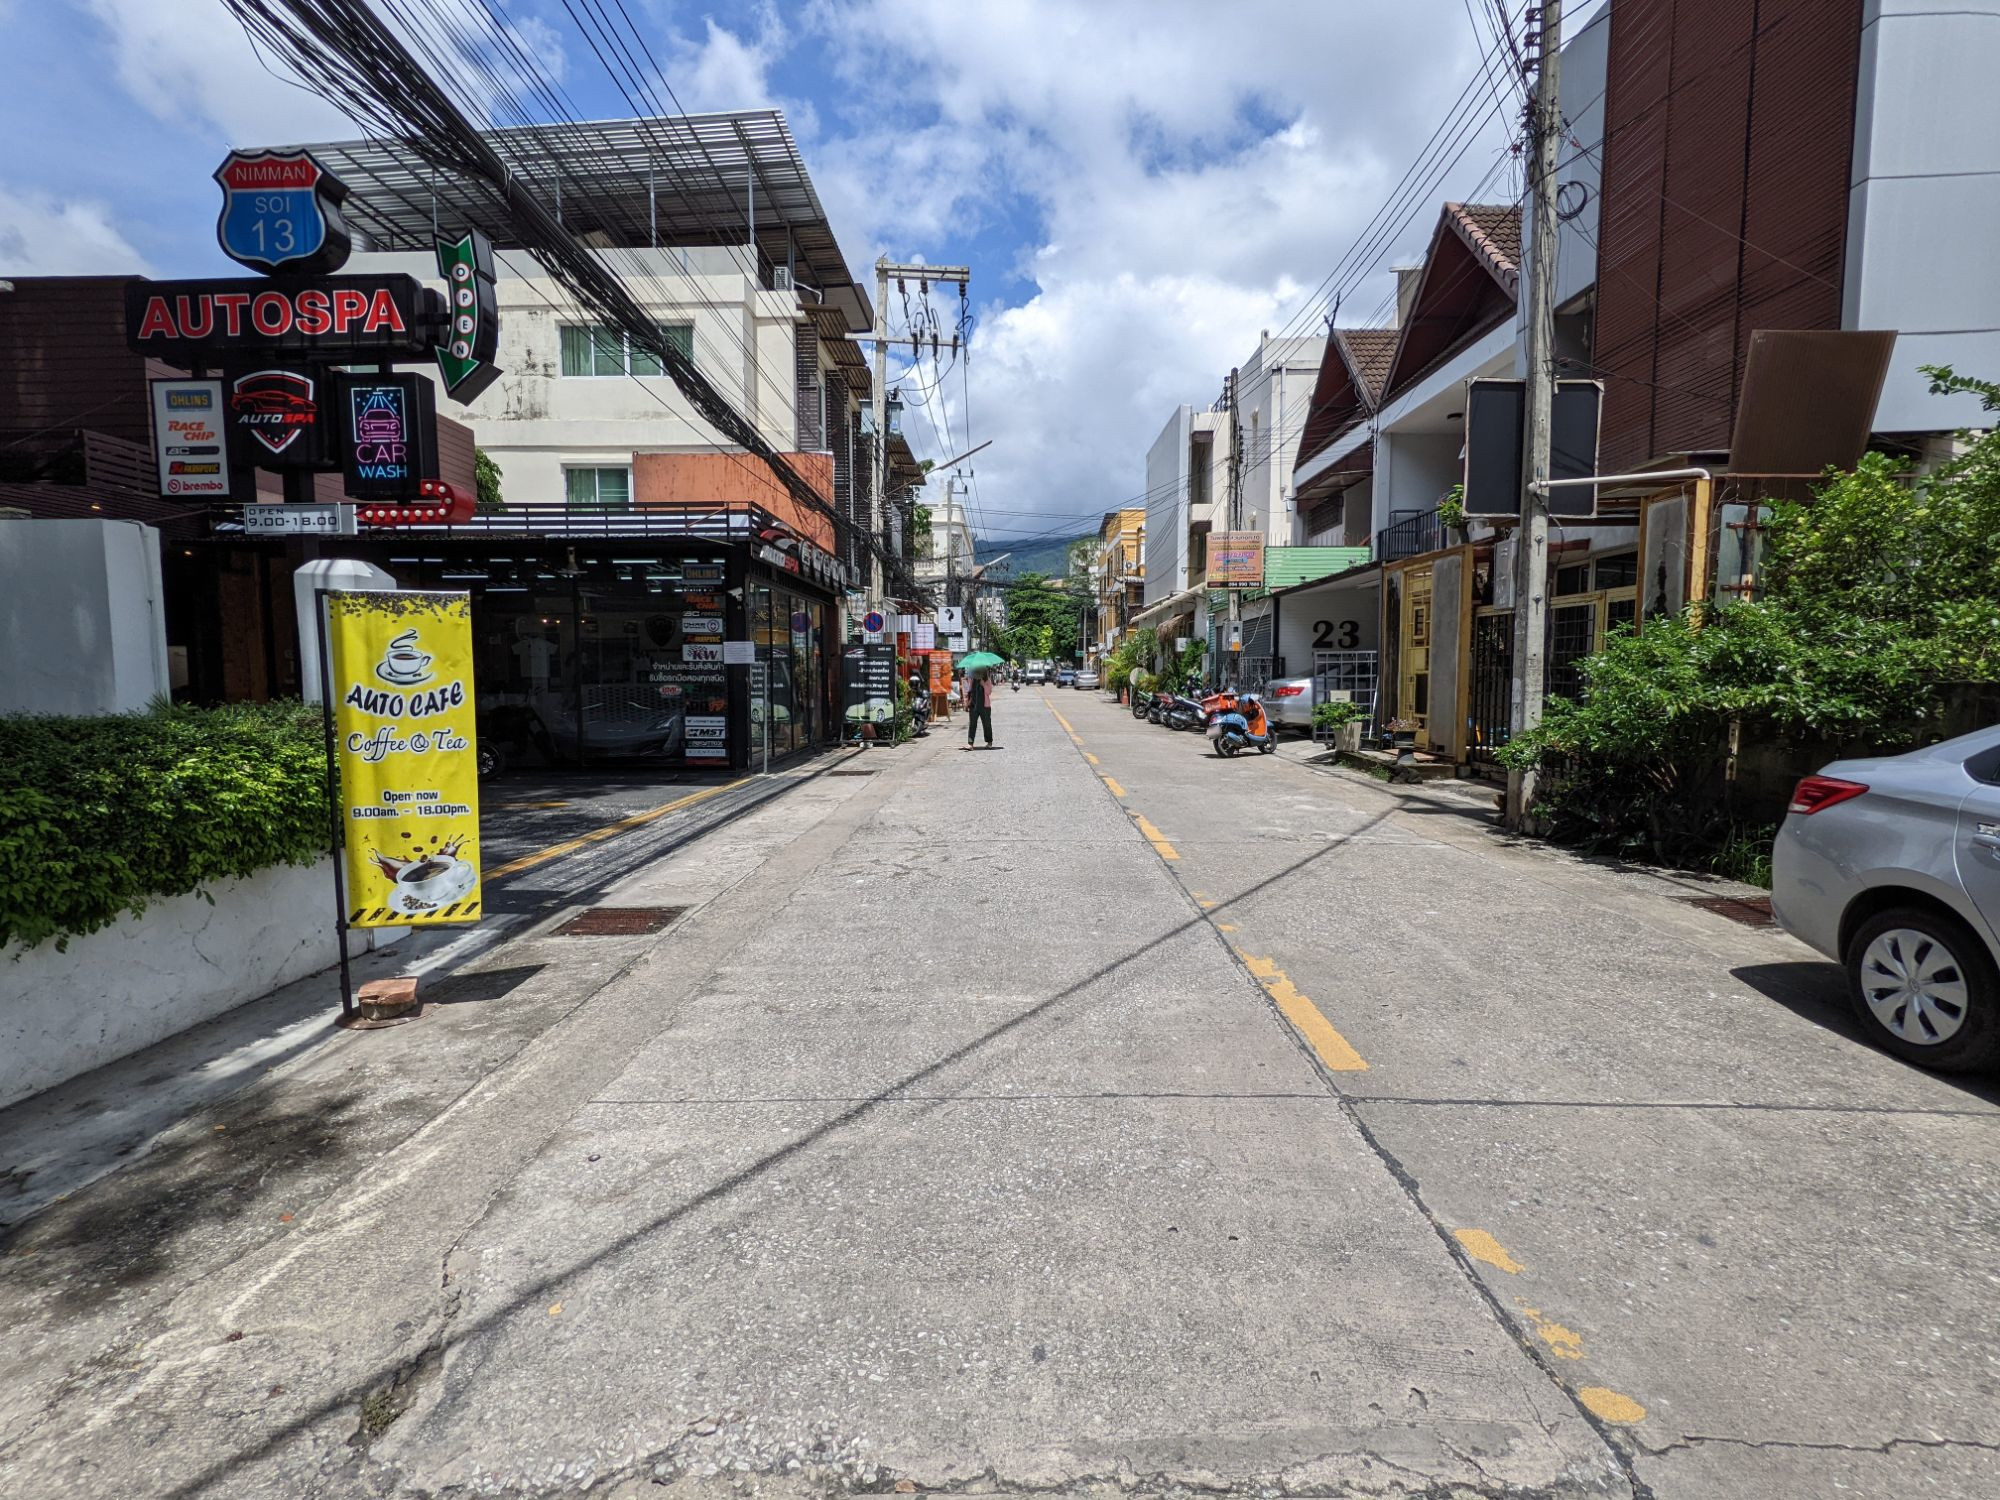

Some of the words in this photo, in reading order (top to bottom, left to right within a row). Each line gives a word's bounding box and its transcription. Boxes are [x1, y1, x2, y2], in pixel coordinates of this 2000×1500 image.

[235, 166, 307, 182] NIMMAN
[255, 196, 290, 214] SOI
[251, 219, 295, 253] 13
[138, 289, 405, 339] AUTOSPA
[453, 264, 475, 358] OPEN
[167, 420, 205, 432] RACE
[239, 413, 316, 424] AUTOSPA
[183, 431, 216, 441] CHIP
[356, 444, 407, 463] CAR
[358, 464, 408, 479] WASH
[182, 481, 224, 491] brembo
[248, 508, 285, 516] OPEN
[248, 516, 337, 527] 9.00-18.00
[1311, 619, 1361, 649] 23
[346, 684, 404, 718] AUTO
[409, 682, 464, 717] CAFE
[698, 728, 724, 736] MST
[347, 727, 408, 761] Coffee
[433, 730, 467, 750] Tea
[383, 791, 411, 804] Open
[416, 791, 438, 801] now
[352, 806, 399, 817] 9.00am.
[416, 805, 470, 817] 18.00pm.
